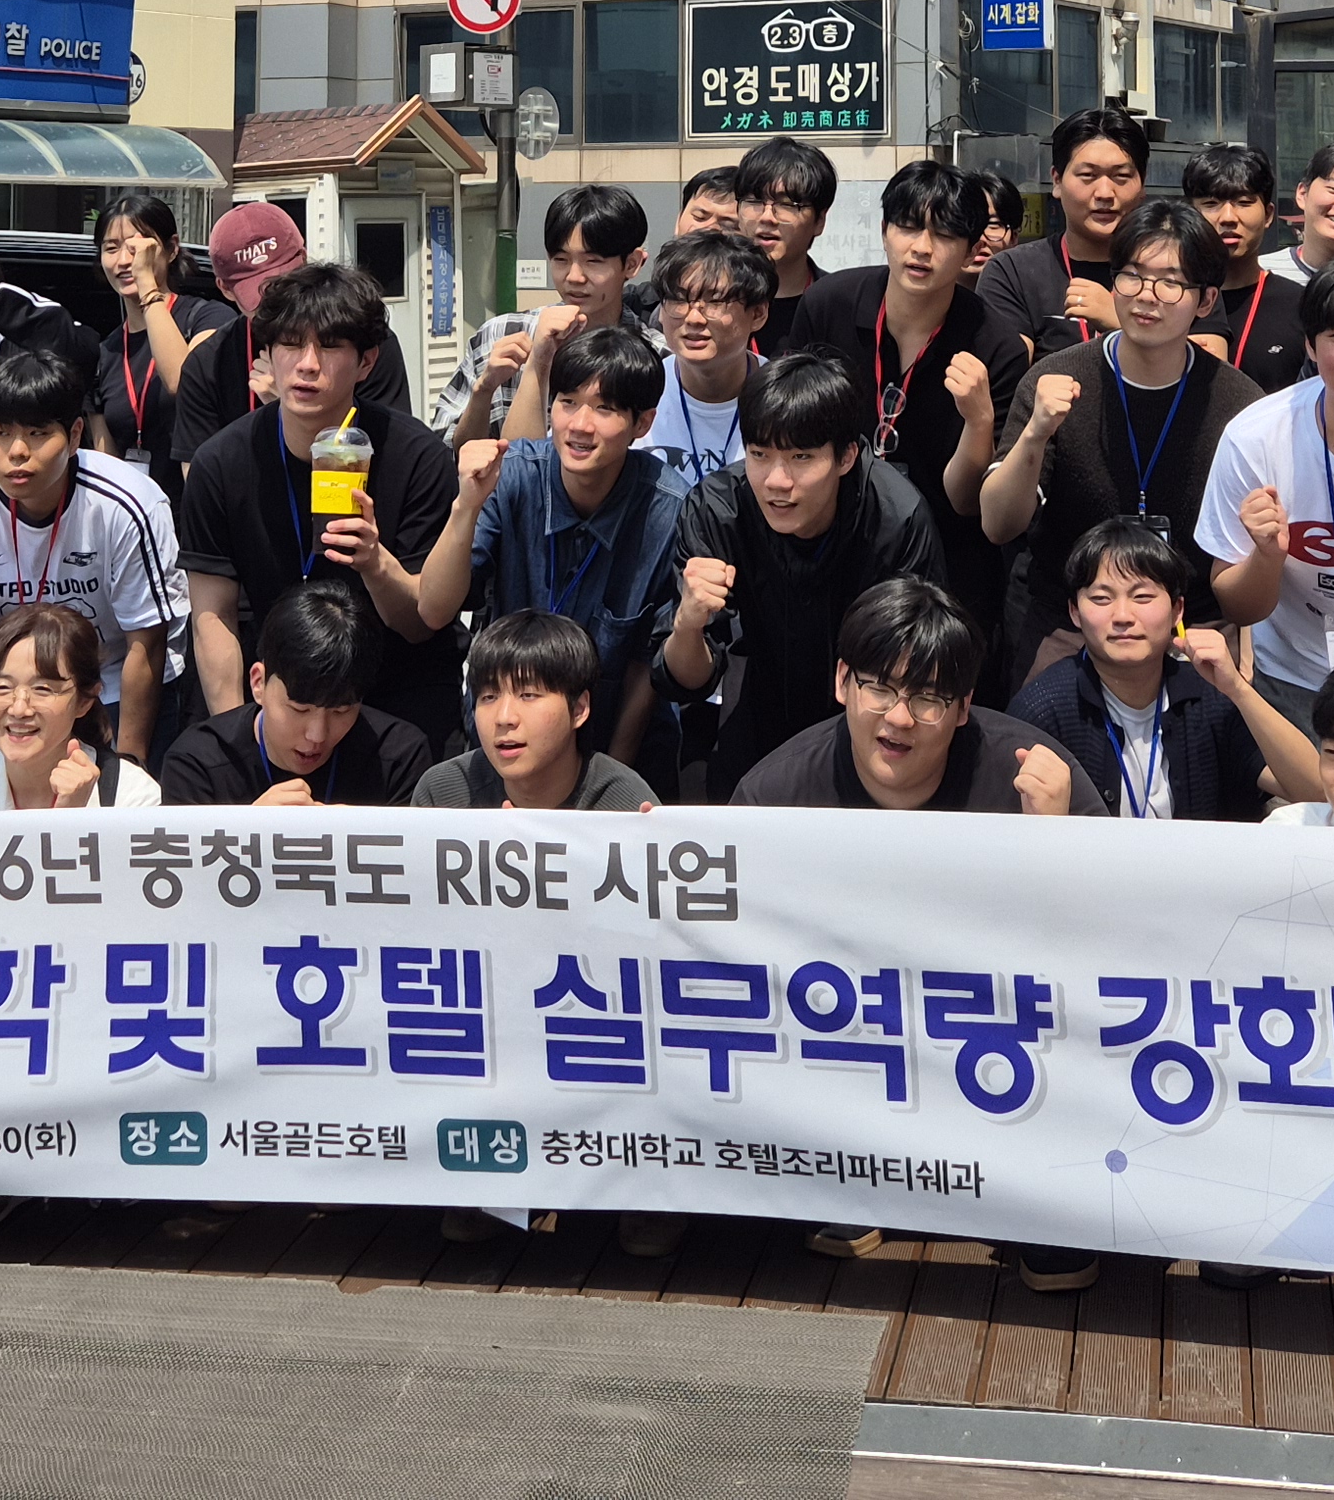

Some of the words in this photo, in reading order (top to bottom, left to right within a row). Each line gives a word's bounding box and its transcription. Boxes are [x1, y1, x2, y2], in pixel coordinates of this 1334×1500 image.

[40, 37, 102, 61] POLICE
[770, 26, 801, 45] 2.3
[822, 24, 838, 43] 층
[702, 65, 759, 106] 안경
[769, 63, 820, 103] 도매
[827, 61, 880, 103] 상가
[720, 110, 774, 129] メガネ
[782, 109, 870, 128] 卸売商店街
[129, 828, 411, 909] 충청북도
[436, 839, 569, 911] RISE
[593, 841, 739, 922] 사업
[105, 942, 207, 1073] 및
[256, 934, 486, 1078] 호텔
[533, 953, 1054, 1114] 실무역량
[220, 1120, 408, 1161] 서울골든호텔
[541, 1128, 706, 1169] 충청대학교
[714, 1138, 985, 1199] 호텔조리파티쉐과
